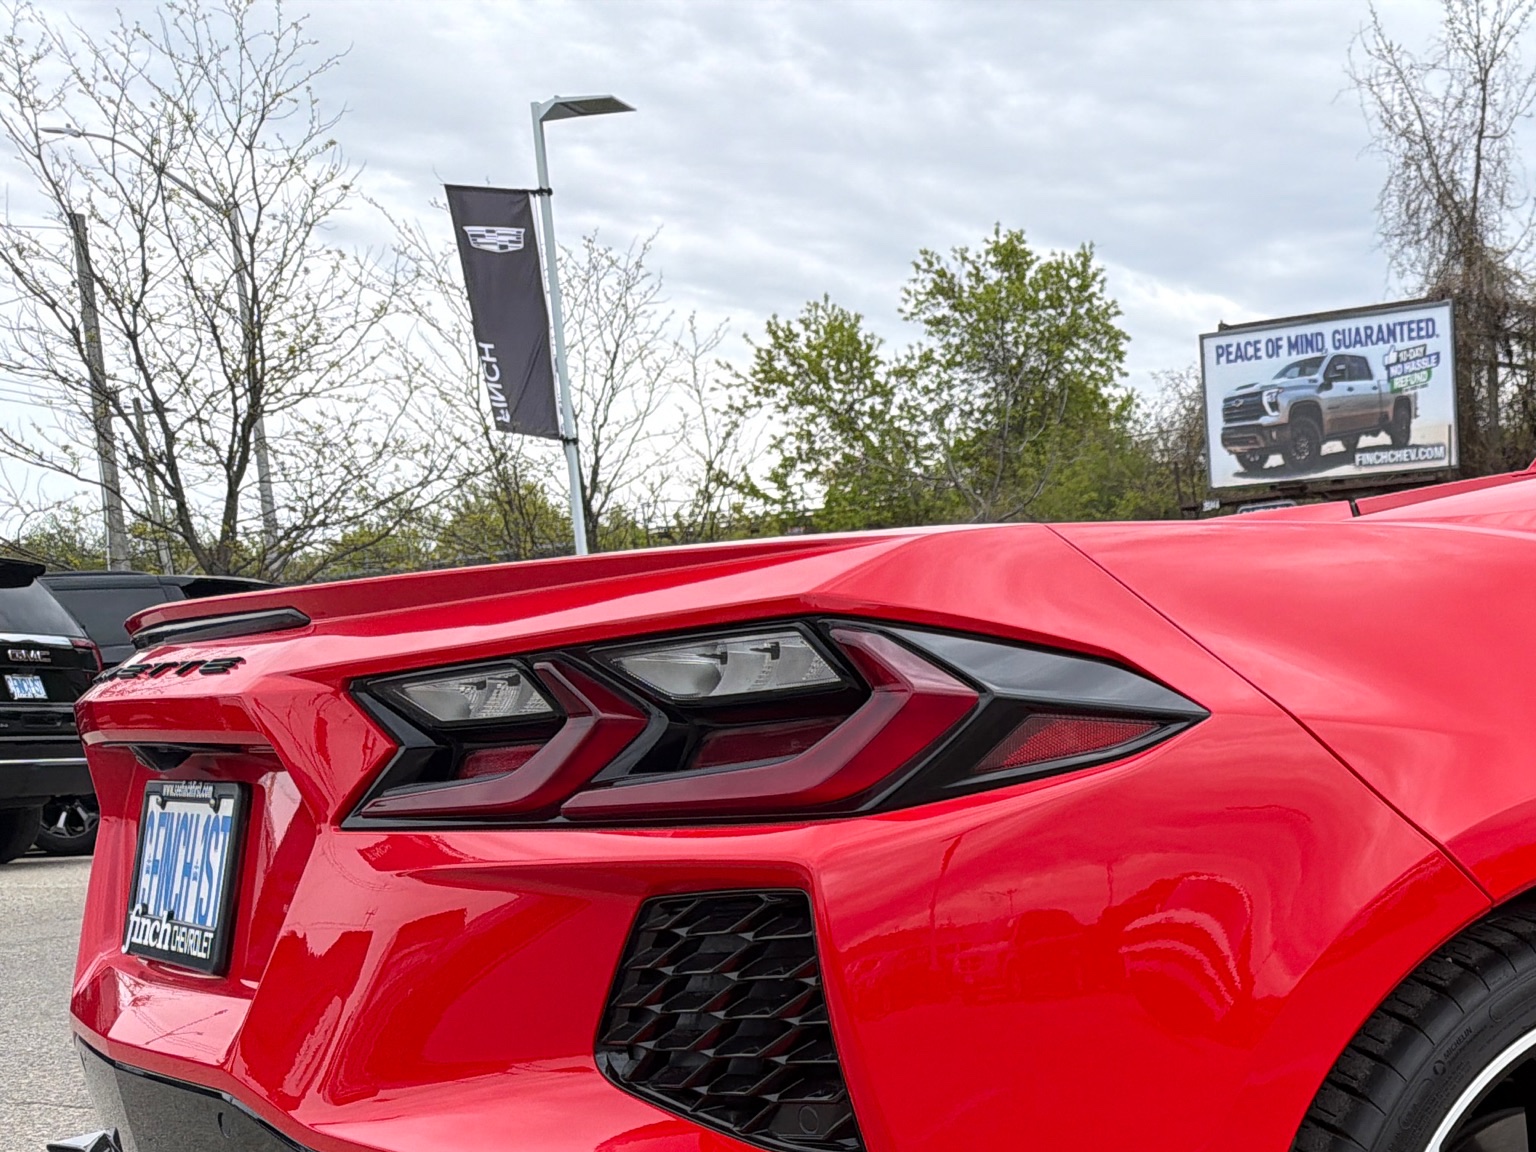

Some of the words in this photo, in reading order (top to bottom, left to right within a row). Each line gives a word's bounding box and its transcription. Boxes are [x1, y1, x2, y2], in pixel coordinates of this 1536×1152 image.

[1215, 340, 1263, 366] PEACE
[1265, 337, 1284, 359] OF
[1332, 318, 1440, 350] GUARANTEED.
[478, 342, 511, 424] FINCH
[1393, 370, 1429, 389] REFUND
[1354, 446, 1445, 467] FINCHCHEV.COM
[8, 649, 52, 663] GMC
[196, 814, 233, 928] 1ST
[121, 903, 170, 955] finch
[170, 926, 214, 960] CHEVROLET
[1443, 1027, 1473, 1060] MICHELIN
